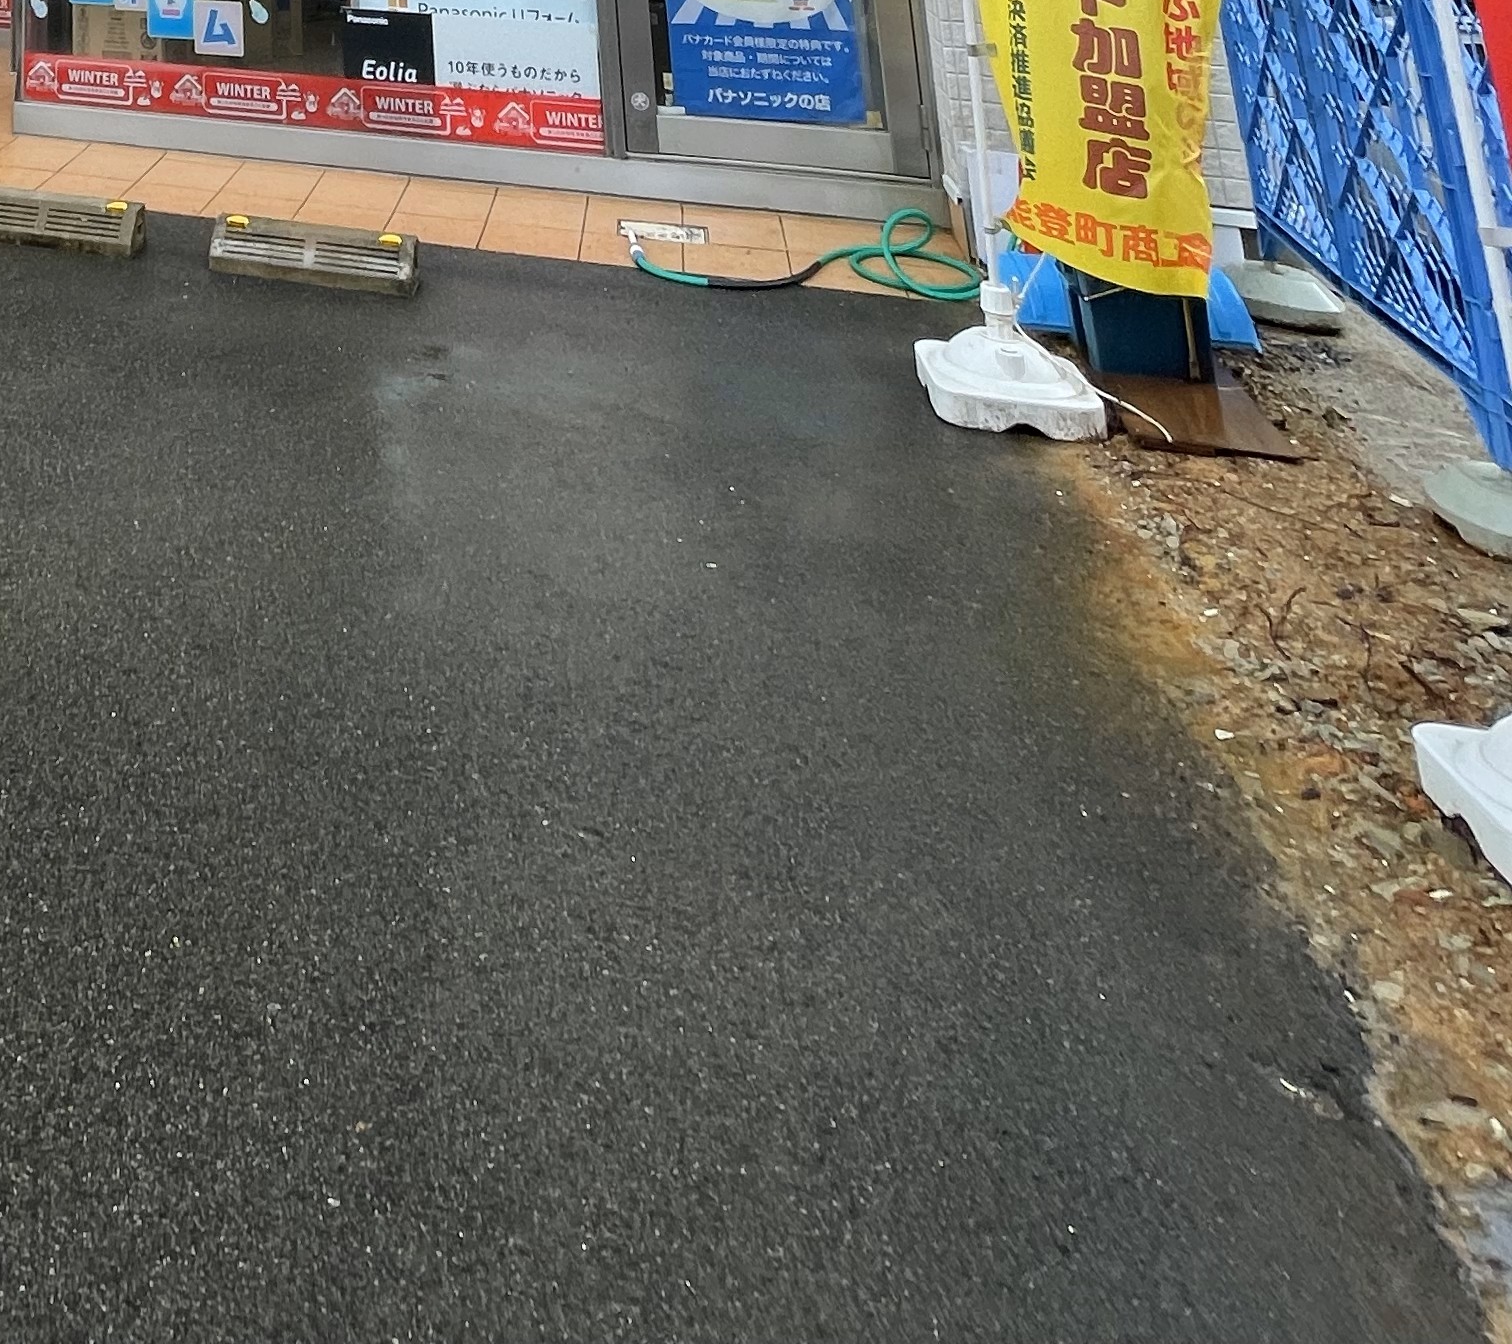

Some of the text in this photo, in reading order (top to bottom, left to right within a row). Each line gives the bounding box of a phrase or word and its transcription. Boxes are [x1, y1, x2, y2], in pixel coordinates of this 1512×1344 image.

[346, 14, 390, 26] Panasonic
[68, 68, 120, 87] WINTER
[361, 58, 419, 84] Eolia
[448, 60, 582, 84] 10年使うものだから
[707, 65, 830, 84] 当店におたずねください。
[216, 81, 272, 100] WINTER
[707, 87, 831, 112] パナソニックの店
[375, 95, 435, 115] WINTER
